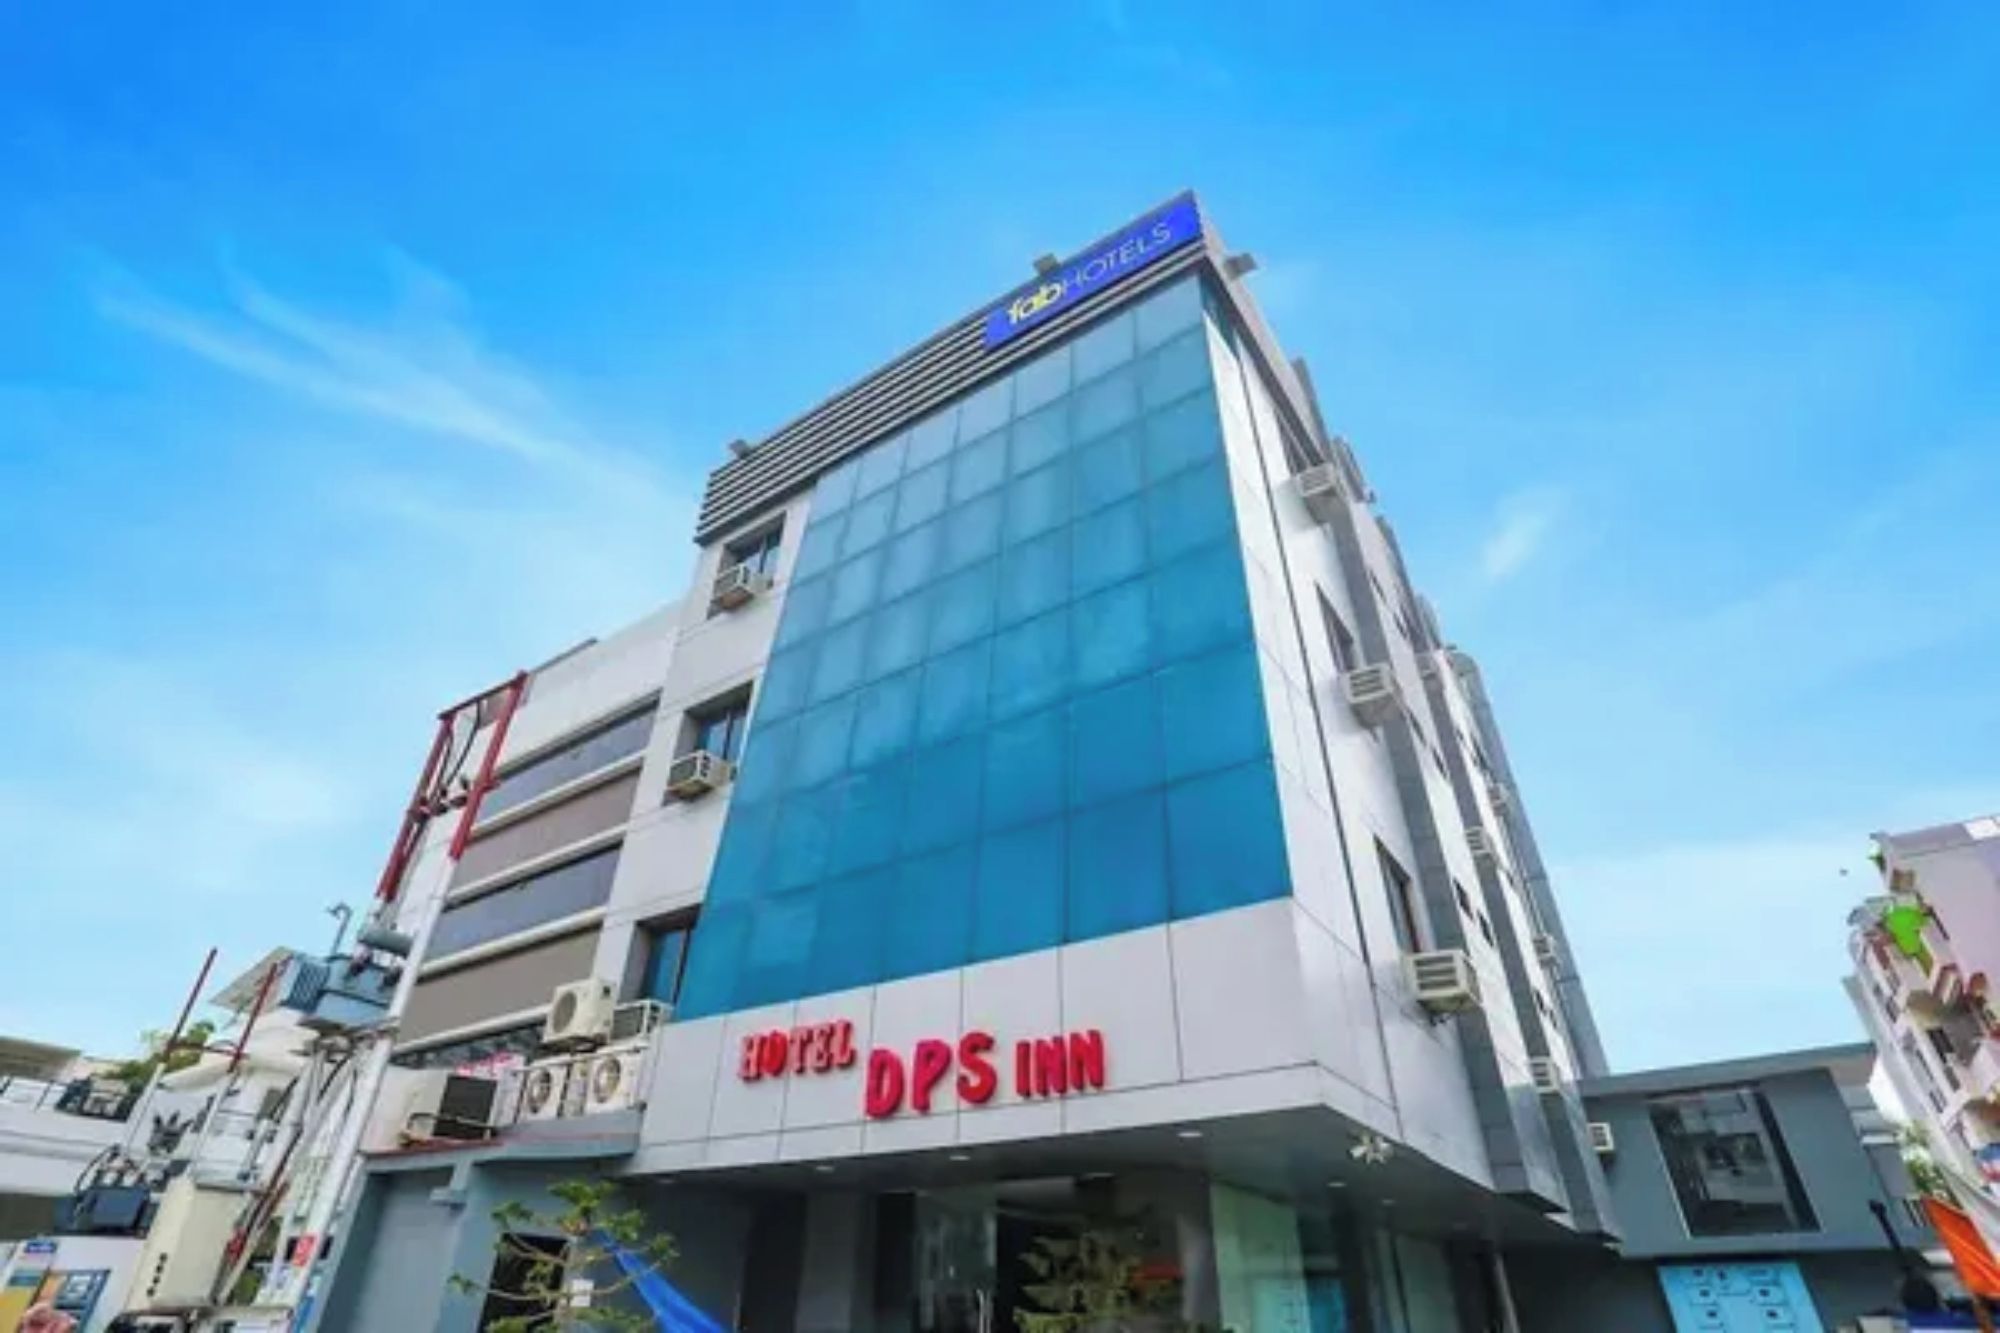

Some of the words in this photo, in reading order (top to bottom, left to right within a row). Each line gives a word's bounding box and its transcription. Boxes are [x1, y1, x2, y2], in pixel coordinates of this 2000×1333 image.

[740, 1020, 855, 1082] HOTEL
[865, 1032, 998, 1119] DPS
[1015, 1029, 1105, 1098] INN
